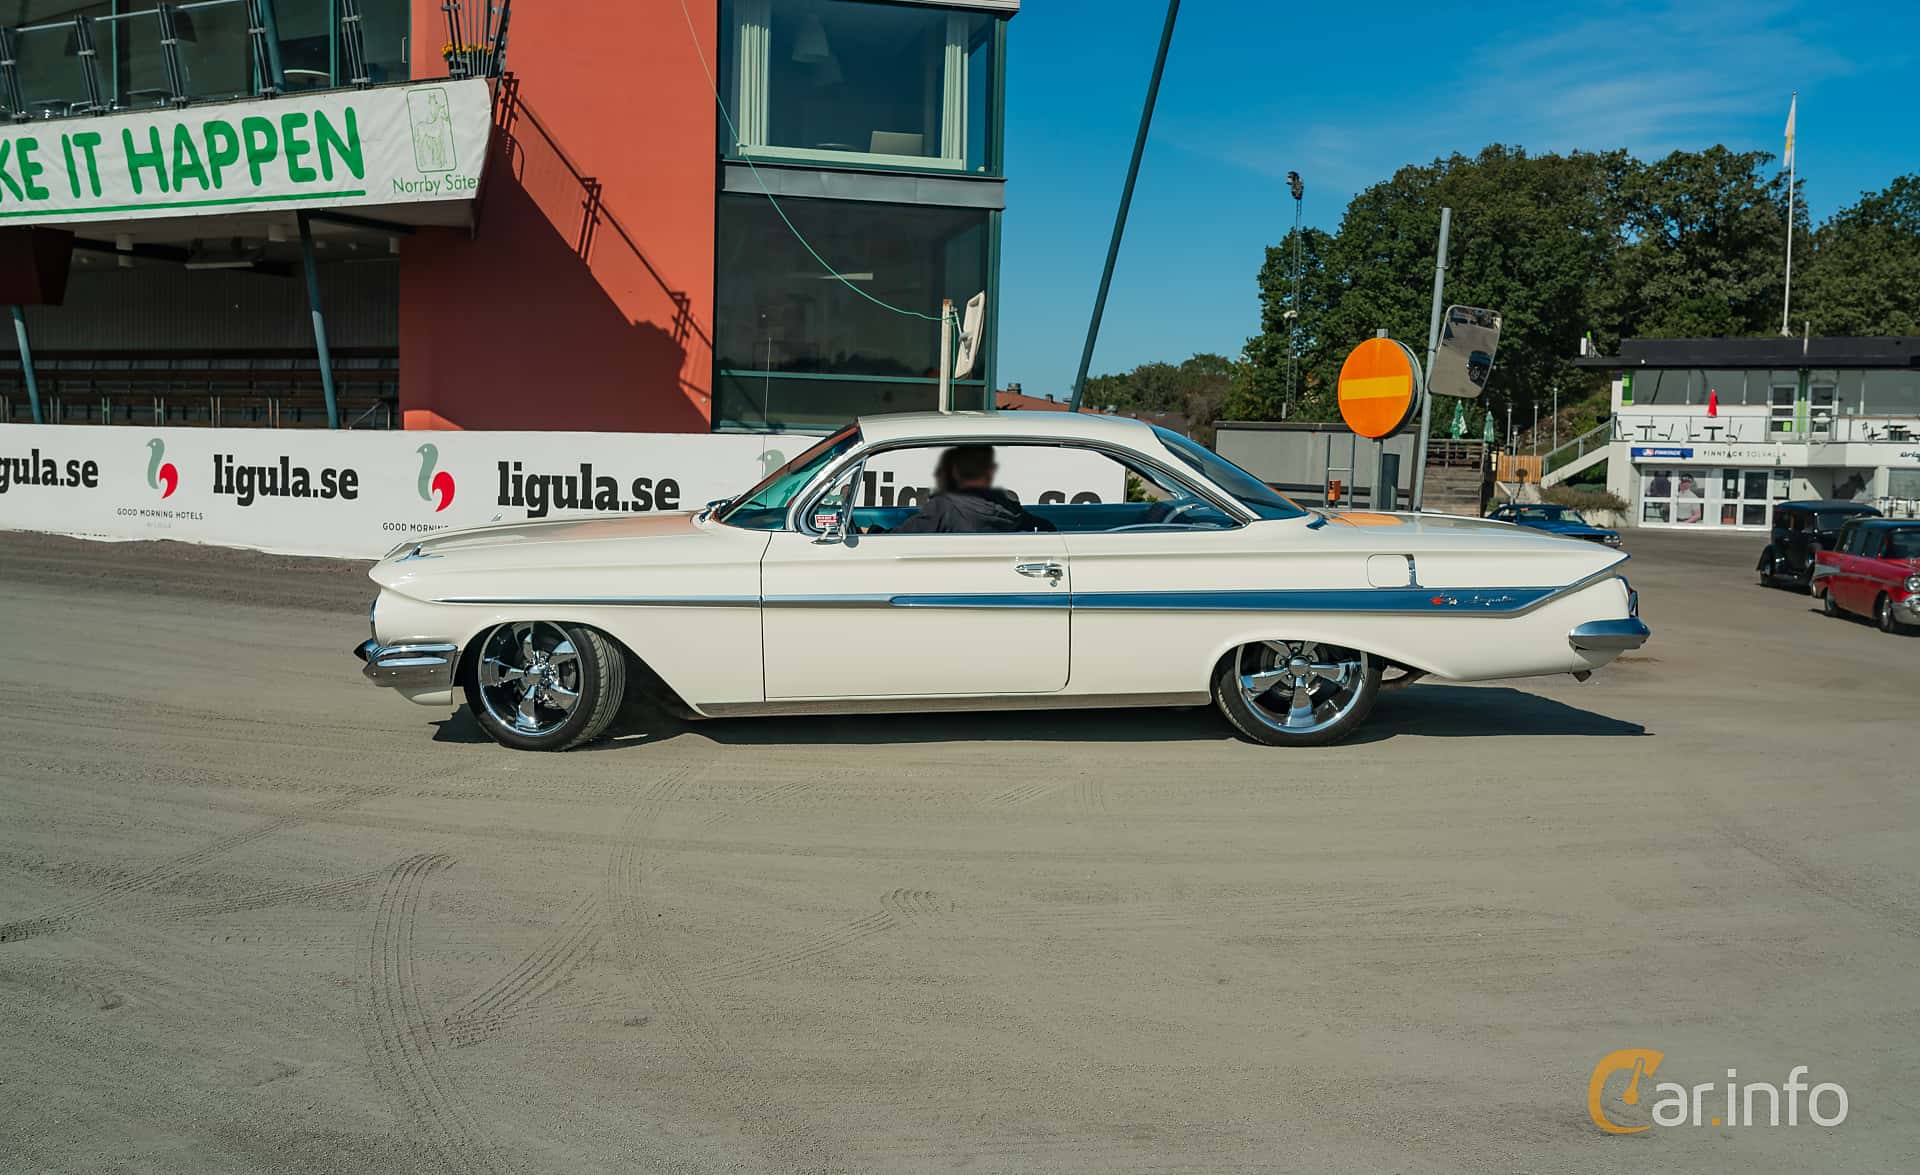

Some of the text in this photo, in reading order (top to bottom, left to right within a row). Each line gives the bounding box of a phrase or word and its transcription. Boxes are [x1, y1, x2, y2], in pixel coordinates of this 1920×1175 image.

[61, 131, 102, 198] IT
[121, 106, 365, 195] HAPPEN
[392, 175, 441, 196] Norrby
[213, 454, 359, 507] ligula.se
[497, 460, 681, 519] ligula.se
[116, 507, 204, 521] GOOD MORNING HOTELS
[382, 522, 407, 532] GOOD
